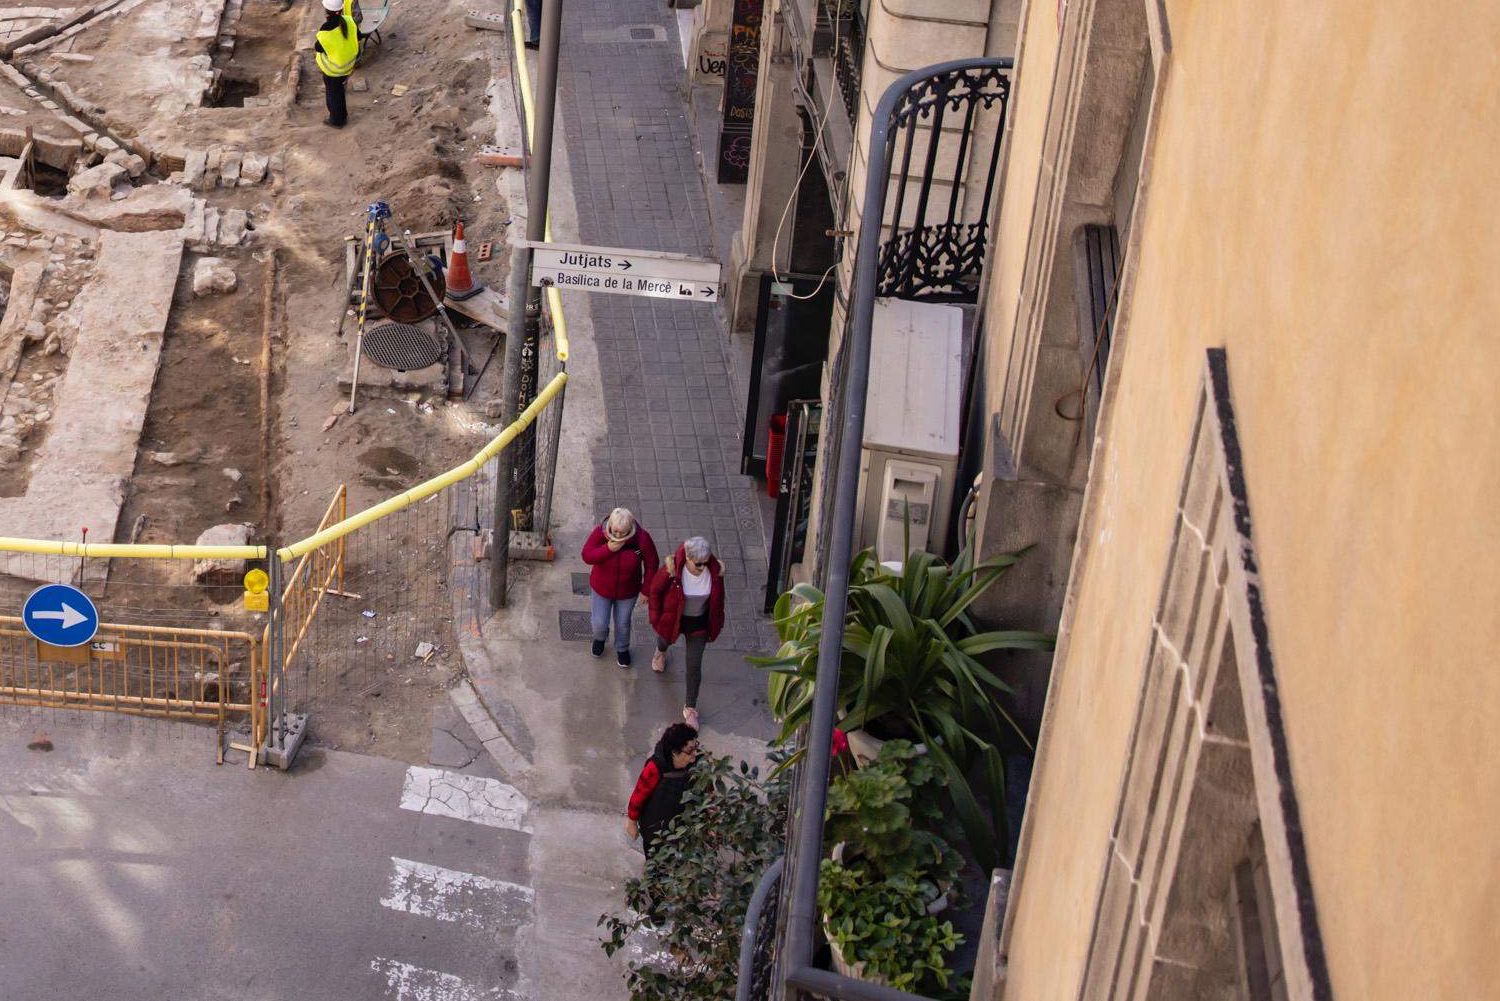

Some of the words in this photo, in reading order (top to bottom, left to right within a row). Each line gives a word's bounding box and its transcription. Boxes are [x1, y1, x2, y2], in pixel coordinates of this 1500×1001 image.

[559, 252, 612, 269] Jutjats
[557, 272, 600, 287] Basílica
[604, 276, 618, 288] de
[622, 277, 632, 290] la
[637, 279, 672, 293] Mercè
[92, 642, 106, 650] CC
